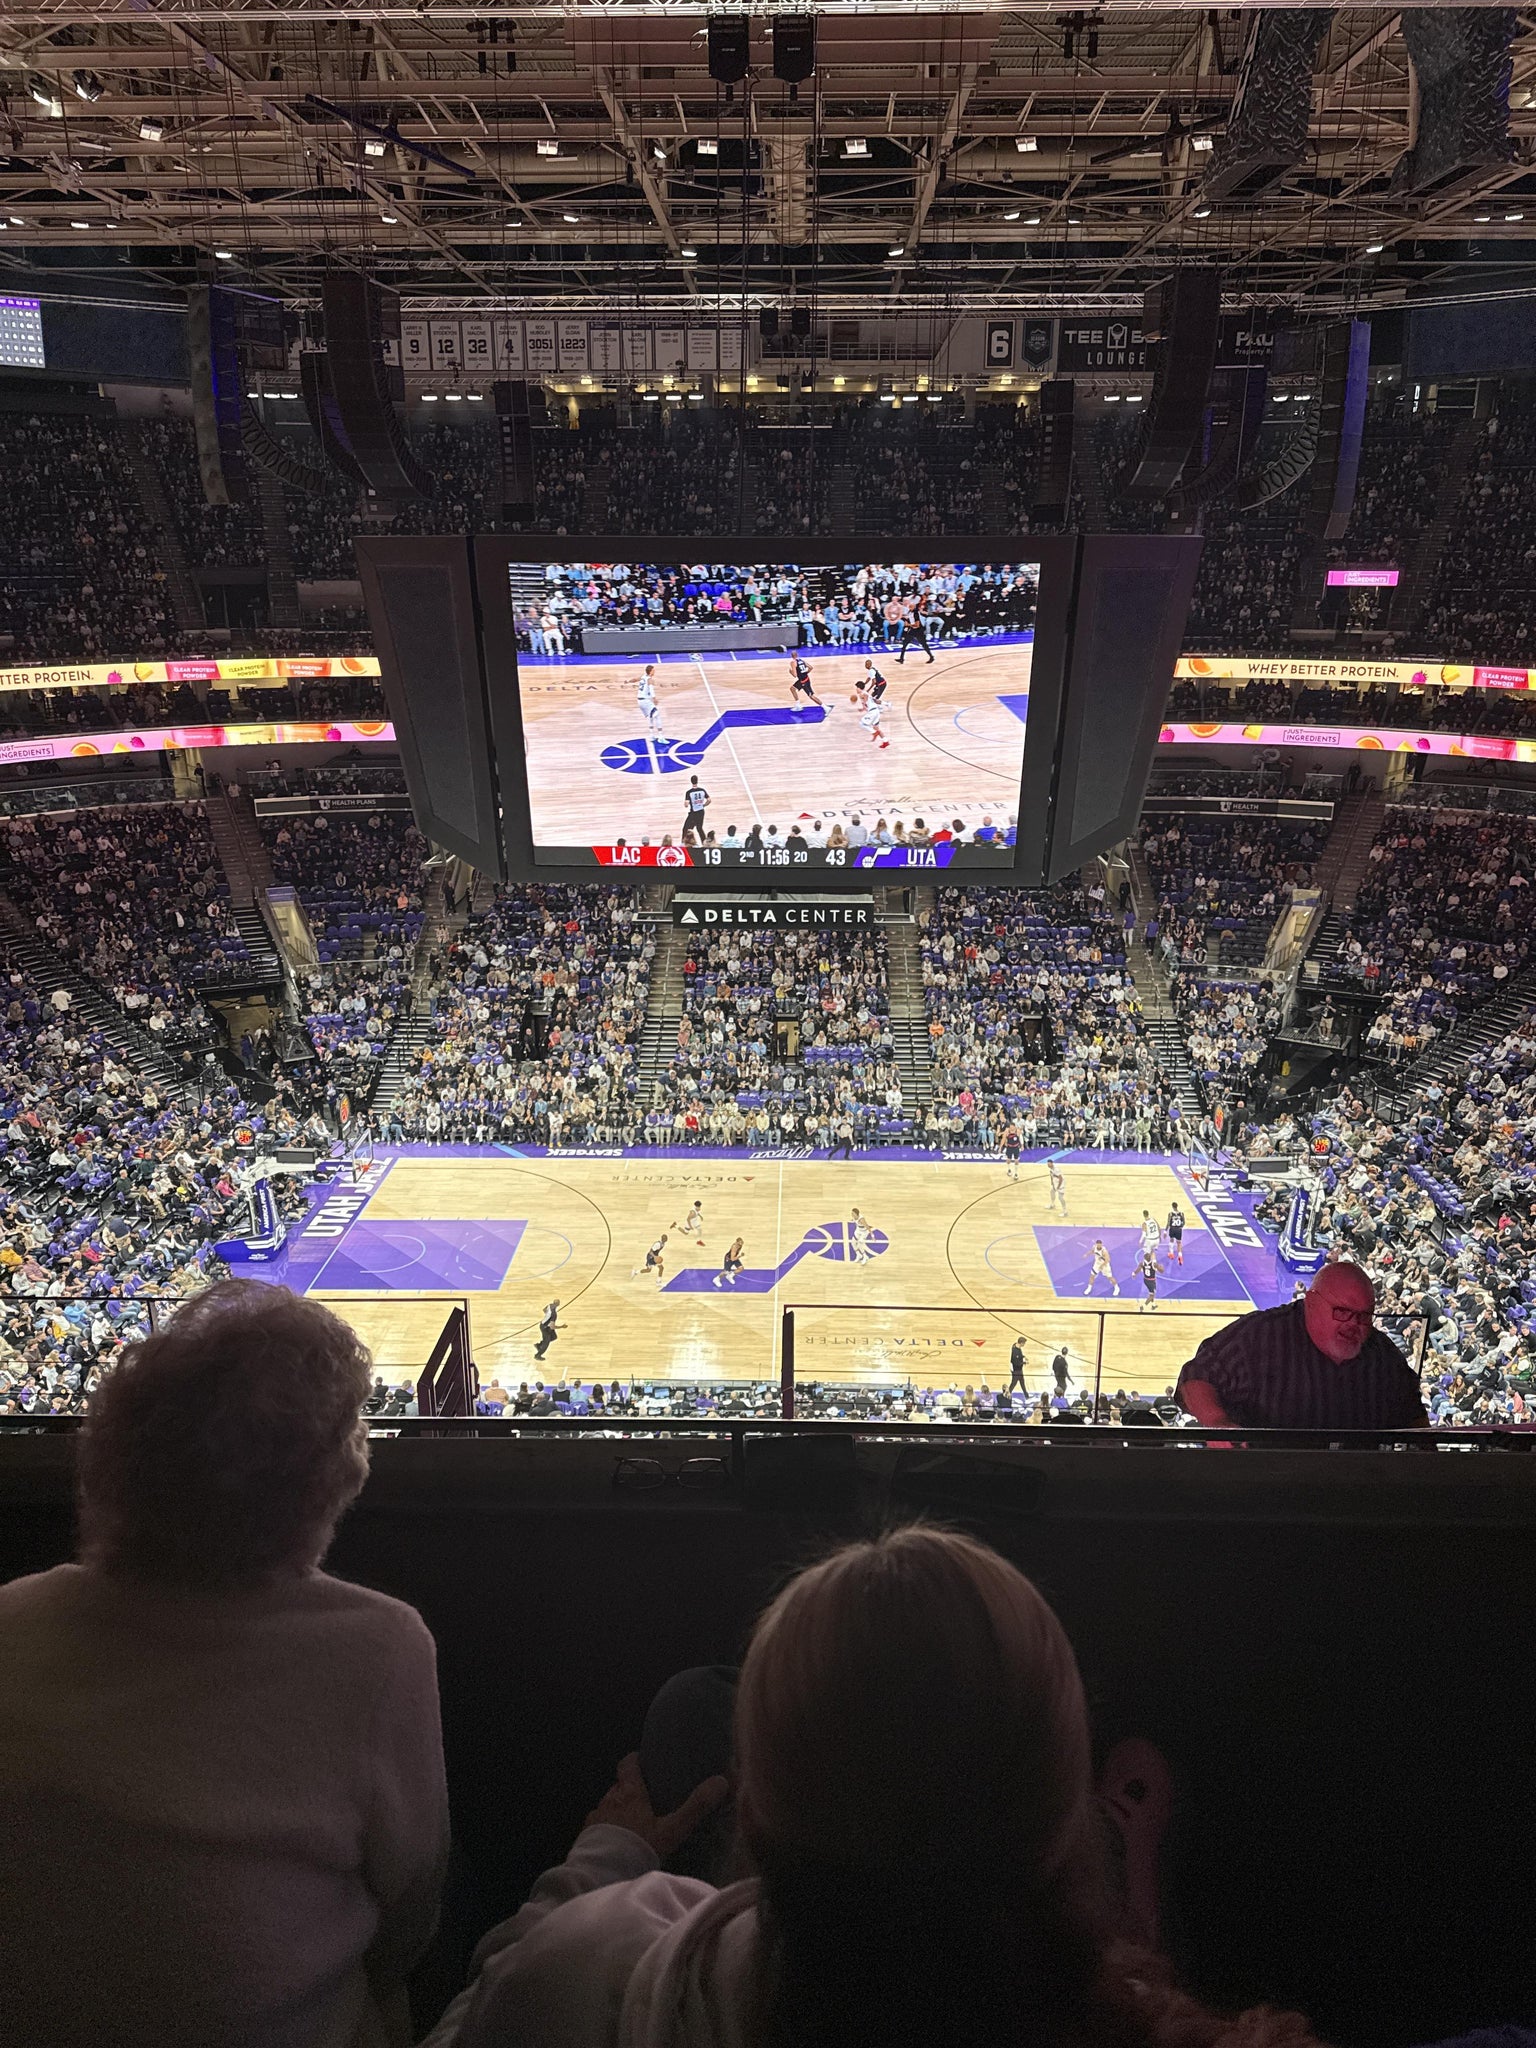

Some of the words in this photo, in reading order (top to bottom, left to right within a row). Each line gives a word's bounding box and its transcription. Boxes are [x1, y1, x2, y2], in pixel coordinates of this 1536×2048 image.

[990, 329, 1009, 359] 6
[1064, 330, 1103, 344] TEE
[410, 339, 420, 354] 9
[438, 339, 454, 354] 12
[468, 339, 487, 354] 32
[505, 339, 514, 353] 4
[528, 339, 553, 350] 3051
[560, 339, 586, 350] 1223
[1087, 351, 1145, 365] LOUNGE
[34, 670, 94, 683] PROTEIN.
[1248, 663, 1288, 674] WHEY
[1291, 664, 1336, 676] BETTER
[1341, 666, 1399, 678] PROTEIN.
[1286, 735, 1337, 743] INGREDIENTS
[822, 807, 903, 818] DELTA
[912, 801, 1009, 814] CENTER
[611, 847, 641, 864] LAC
[703, 849, 722, 865] 19
[739, 851, 755, 863] 2ND
[759, 849, 790, 865] 11:56
[794, 851, 808, 863] 20
[825, 849, 846, 866] 43
[907, 849, 936, 865] UTA
[704, 909, 777, 923] DELTA
[785, 909, 867, 923] CENTER
[546, 1148, 624, 1157] SEATGEEK
[300, 1195, 367, 1237] UTAH
[1171, 1218, 1181, 1227] 20
[1201, 1204, 1265, 1248] JAZZ
[805, 1336, 884, 1346] CENTER
[893, 1338, 964, 1347] DELTA
